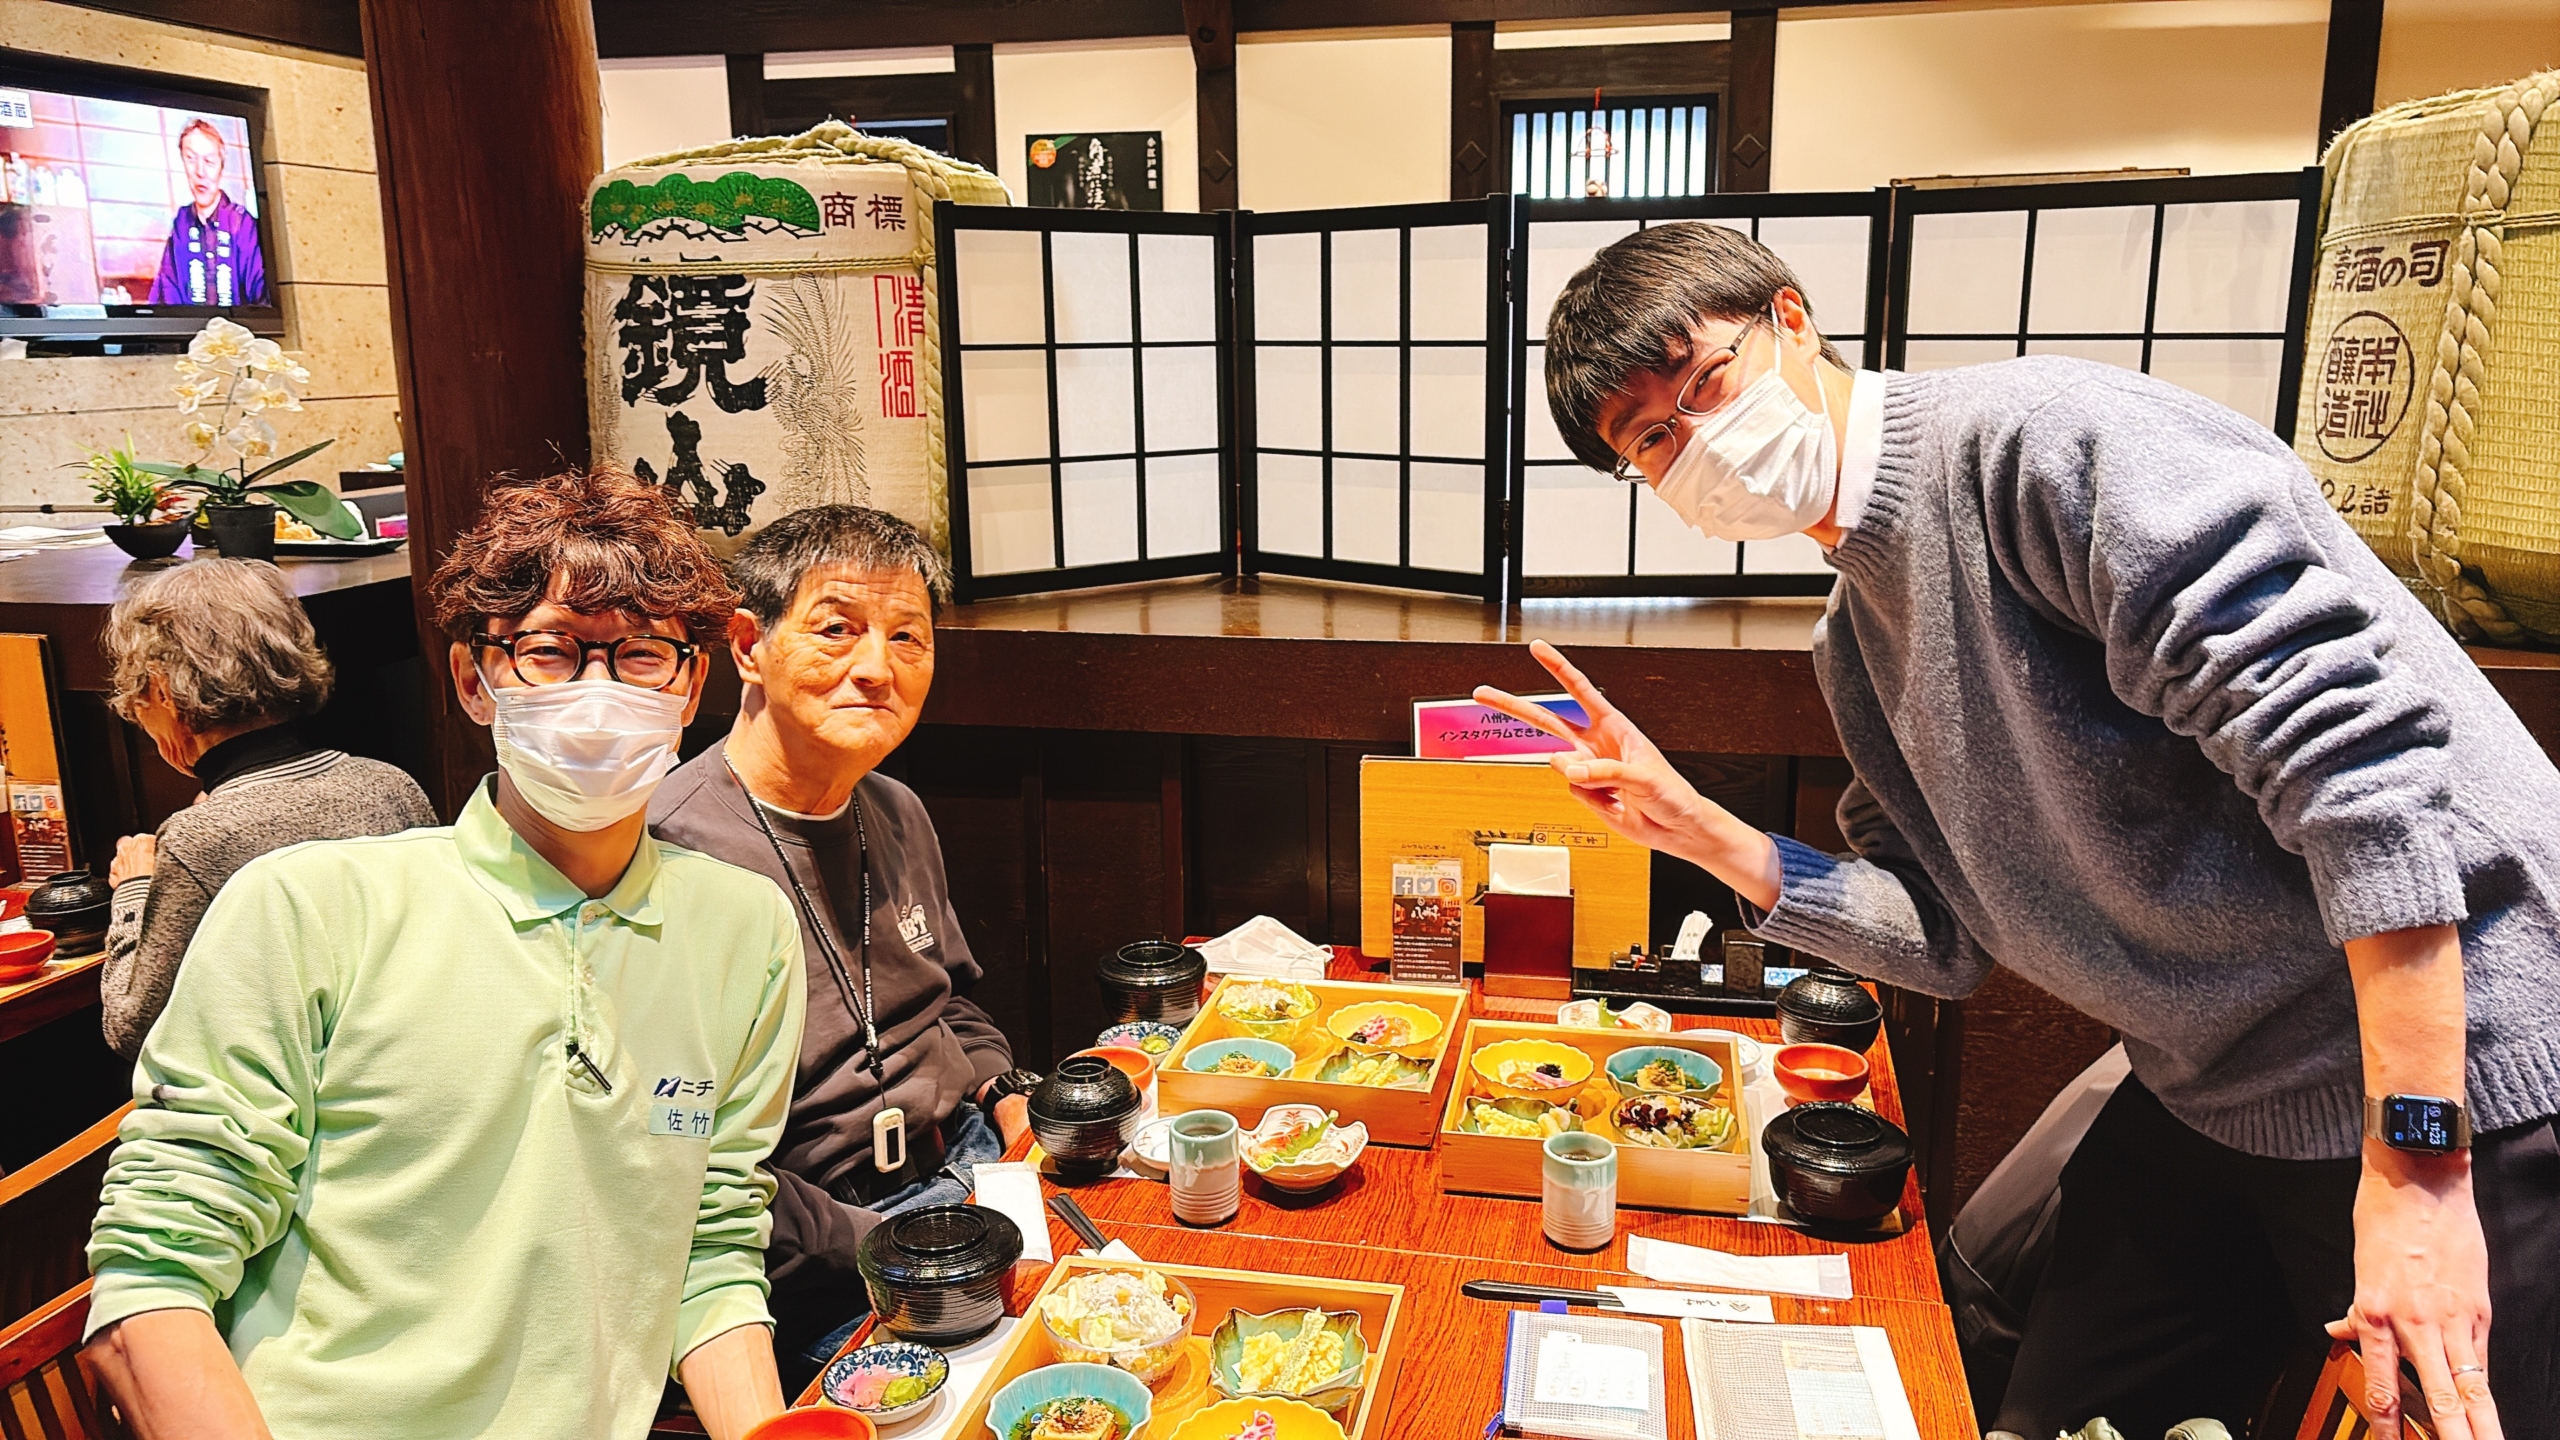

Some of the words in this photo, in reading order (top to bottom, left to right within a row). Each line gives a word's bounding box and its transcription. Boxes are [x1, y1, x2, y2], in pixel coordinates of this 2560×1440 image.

[821, 191, 907, 231] 商標
[615, 252, 779, 537] 鏡山
[1481, 713, 1519, 724] 八州亭
[1439, 727, 1554, 742] インスタグラムできま
[667, 1108, 710, 1134] 佐竹
